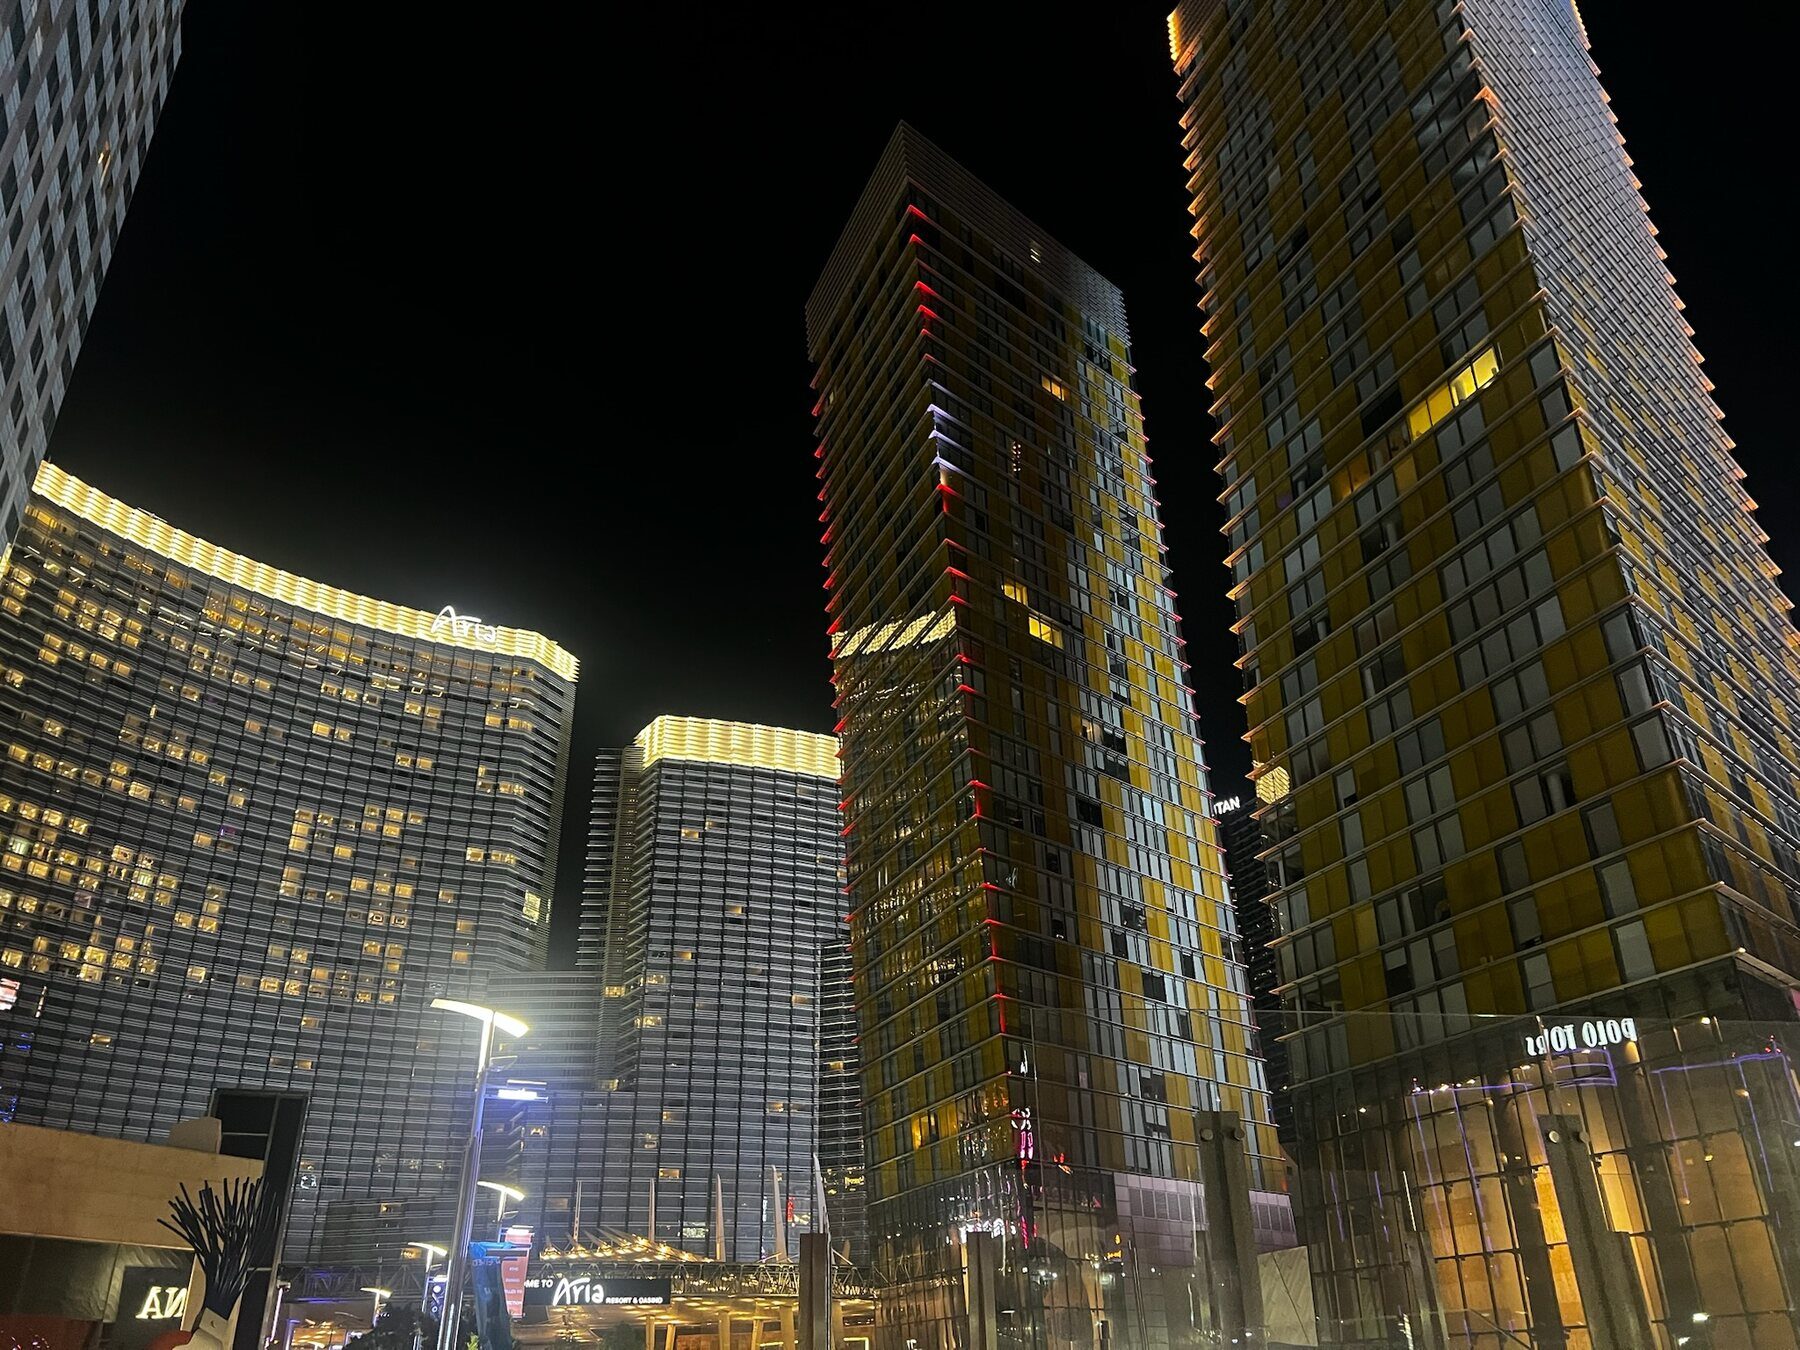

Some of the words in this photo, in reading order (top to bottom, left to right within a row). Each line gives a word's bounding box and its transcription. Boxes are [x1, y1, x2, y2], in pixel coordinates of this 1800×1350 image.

[1212, 796, 1240, 816] ITAN
[524, 1279, 540, 1288] ME
[541, 1279, 553, 1288] TO
[552, 1277, 604, 1306] Aria
[605, 1296, 632, 1304] RESORT
